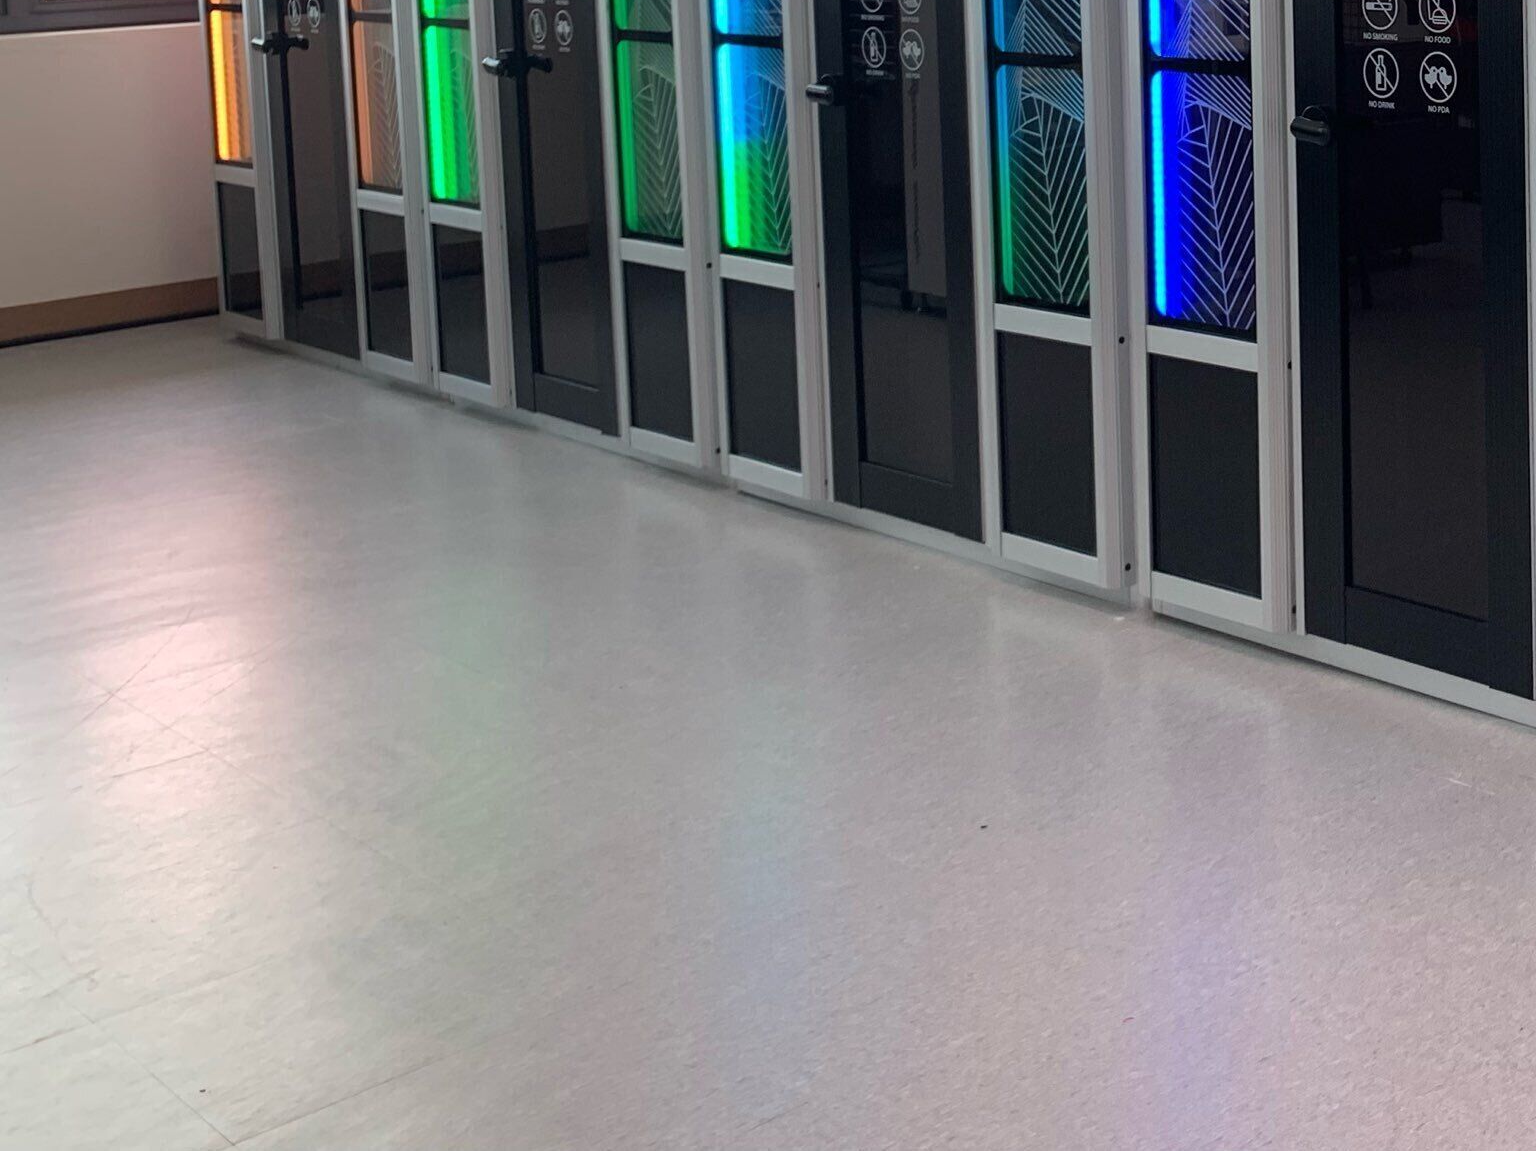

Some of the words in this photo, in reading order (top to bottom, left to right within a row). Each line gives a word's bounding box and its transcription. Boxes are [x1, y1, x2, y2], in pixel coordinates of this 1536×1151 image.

[1363, 32, 1372, 40] NO
[1424, 35, 1433, 43] NO
[1434, 36, 1451, 44] FOOD
[1368, 100, 1377, 108] NO
[1428, 105, 1437, 113] NO
[1437, 106, 1450, 114] PDA
